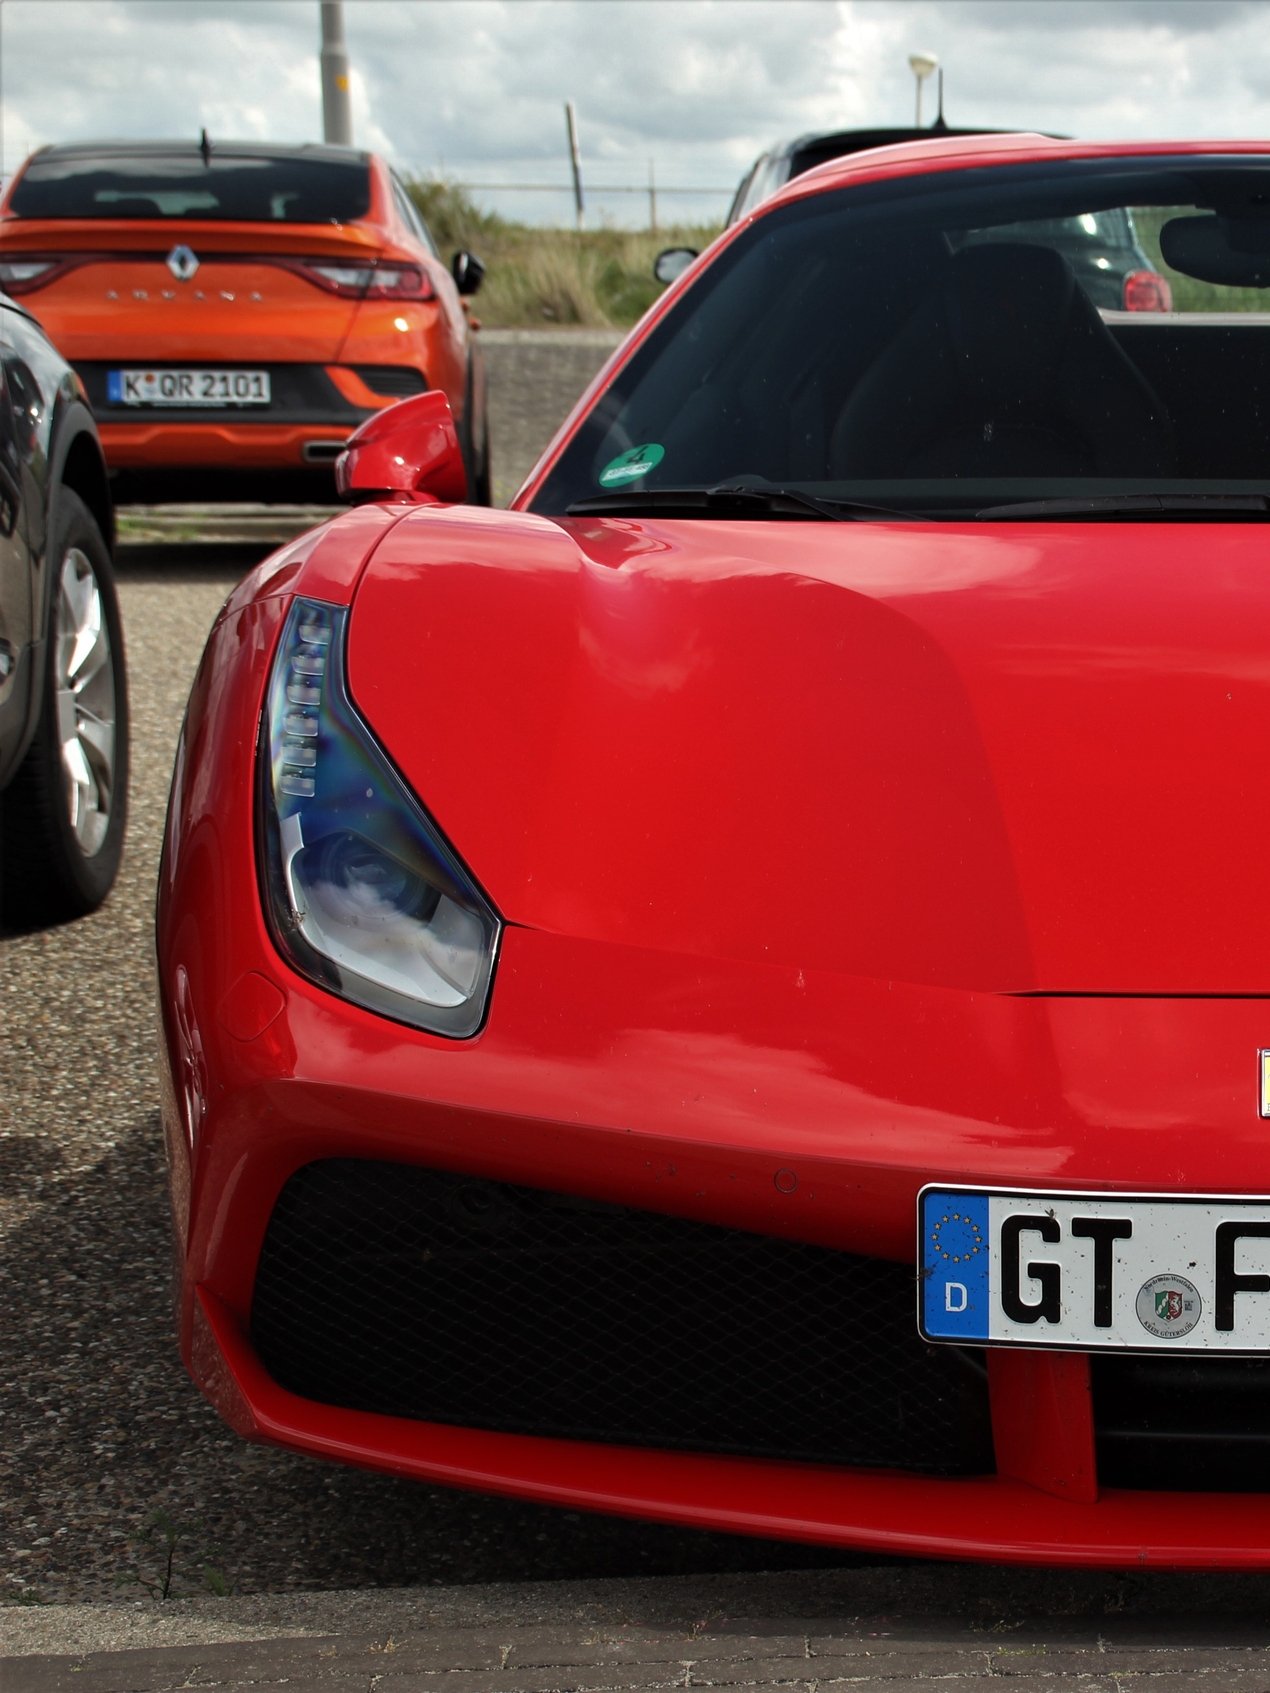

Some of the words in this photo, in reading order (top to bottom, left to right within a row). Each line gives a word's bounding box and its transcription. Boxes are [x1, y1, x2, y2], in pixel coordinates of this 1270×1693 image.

[106, 288, 263, 301] ARKANA
[125, 375, 142, 398] K
[160, 374, 194, 397] QR
[201, 374, 264, 397] 2101
[1001, 1215, 1132, 1327] GT
[945, 1282, 968, 1311] D
[1144, 1320, 1159, 1335] KREIS
